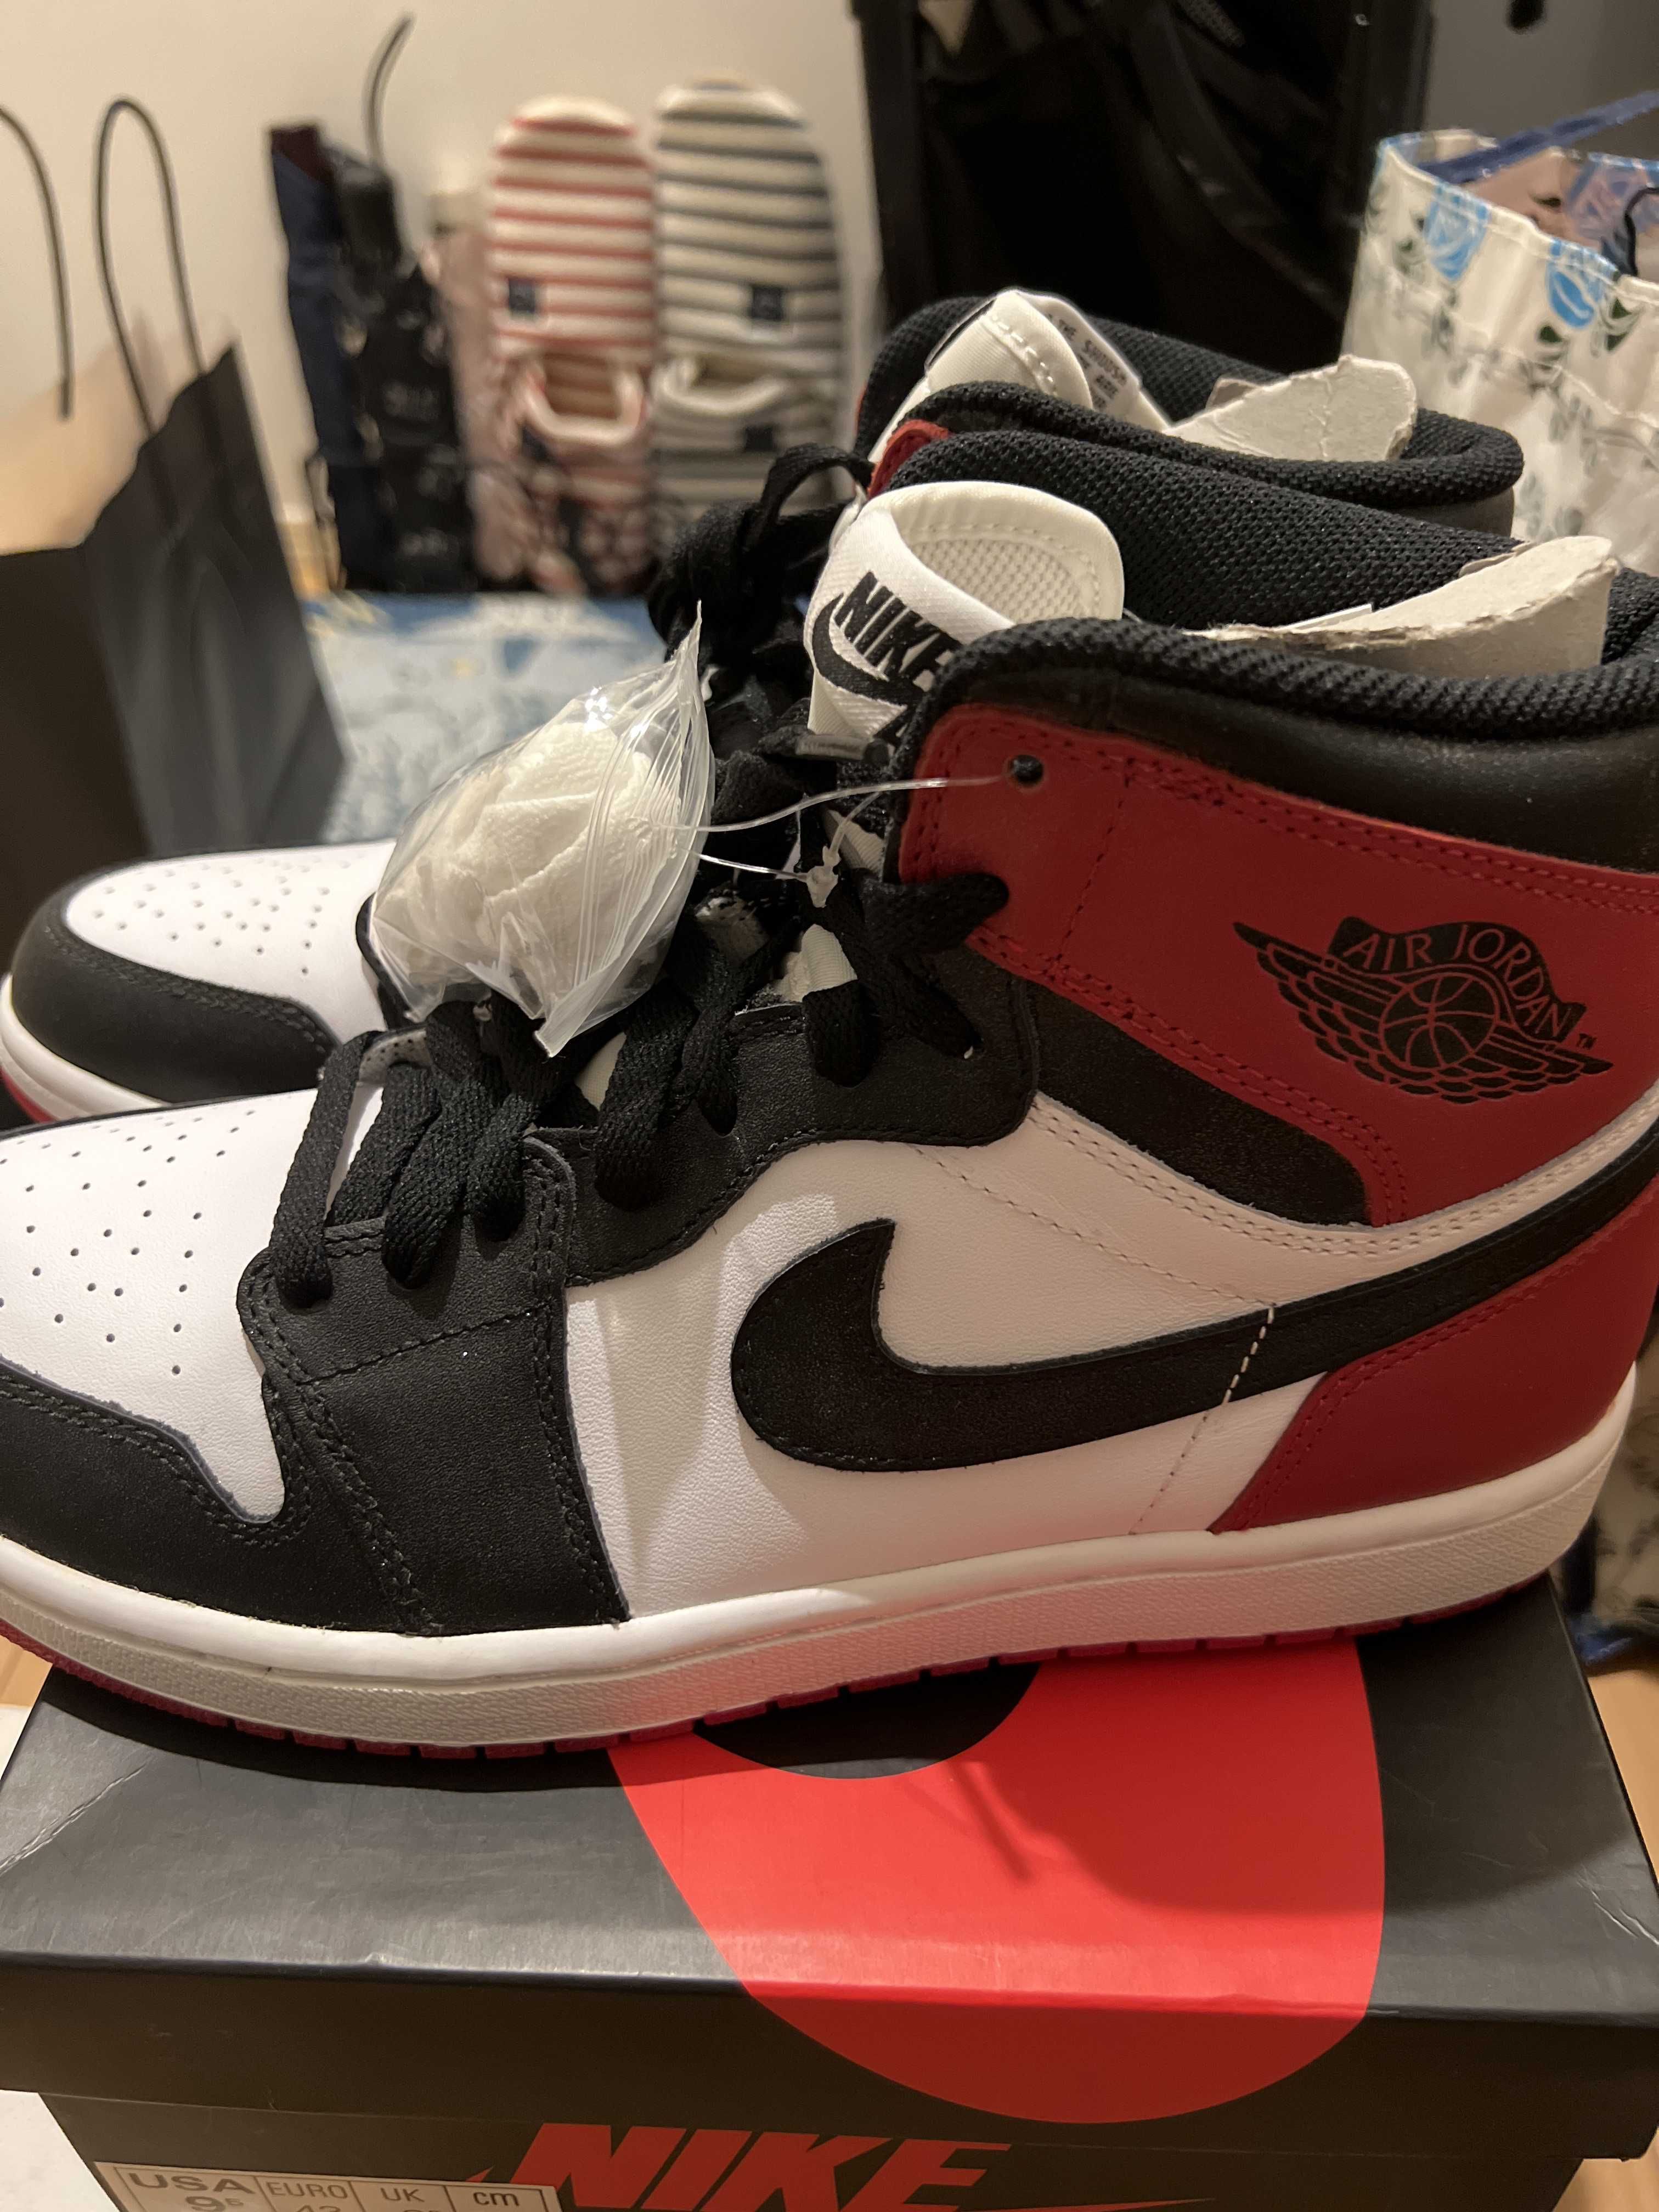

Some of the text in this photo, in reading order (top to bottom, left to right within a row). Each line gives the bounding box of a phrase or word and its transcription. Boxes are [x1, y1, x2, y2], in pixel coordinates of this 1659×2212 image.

[834, 571, 963, 692] NIKE
[1342, 924, 1572, 1037] AIR JORDAN
[128, 2172, 520, 2207] USA EURO UK cm
[509, 2123, 1012, 2212] NIKE
